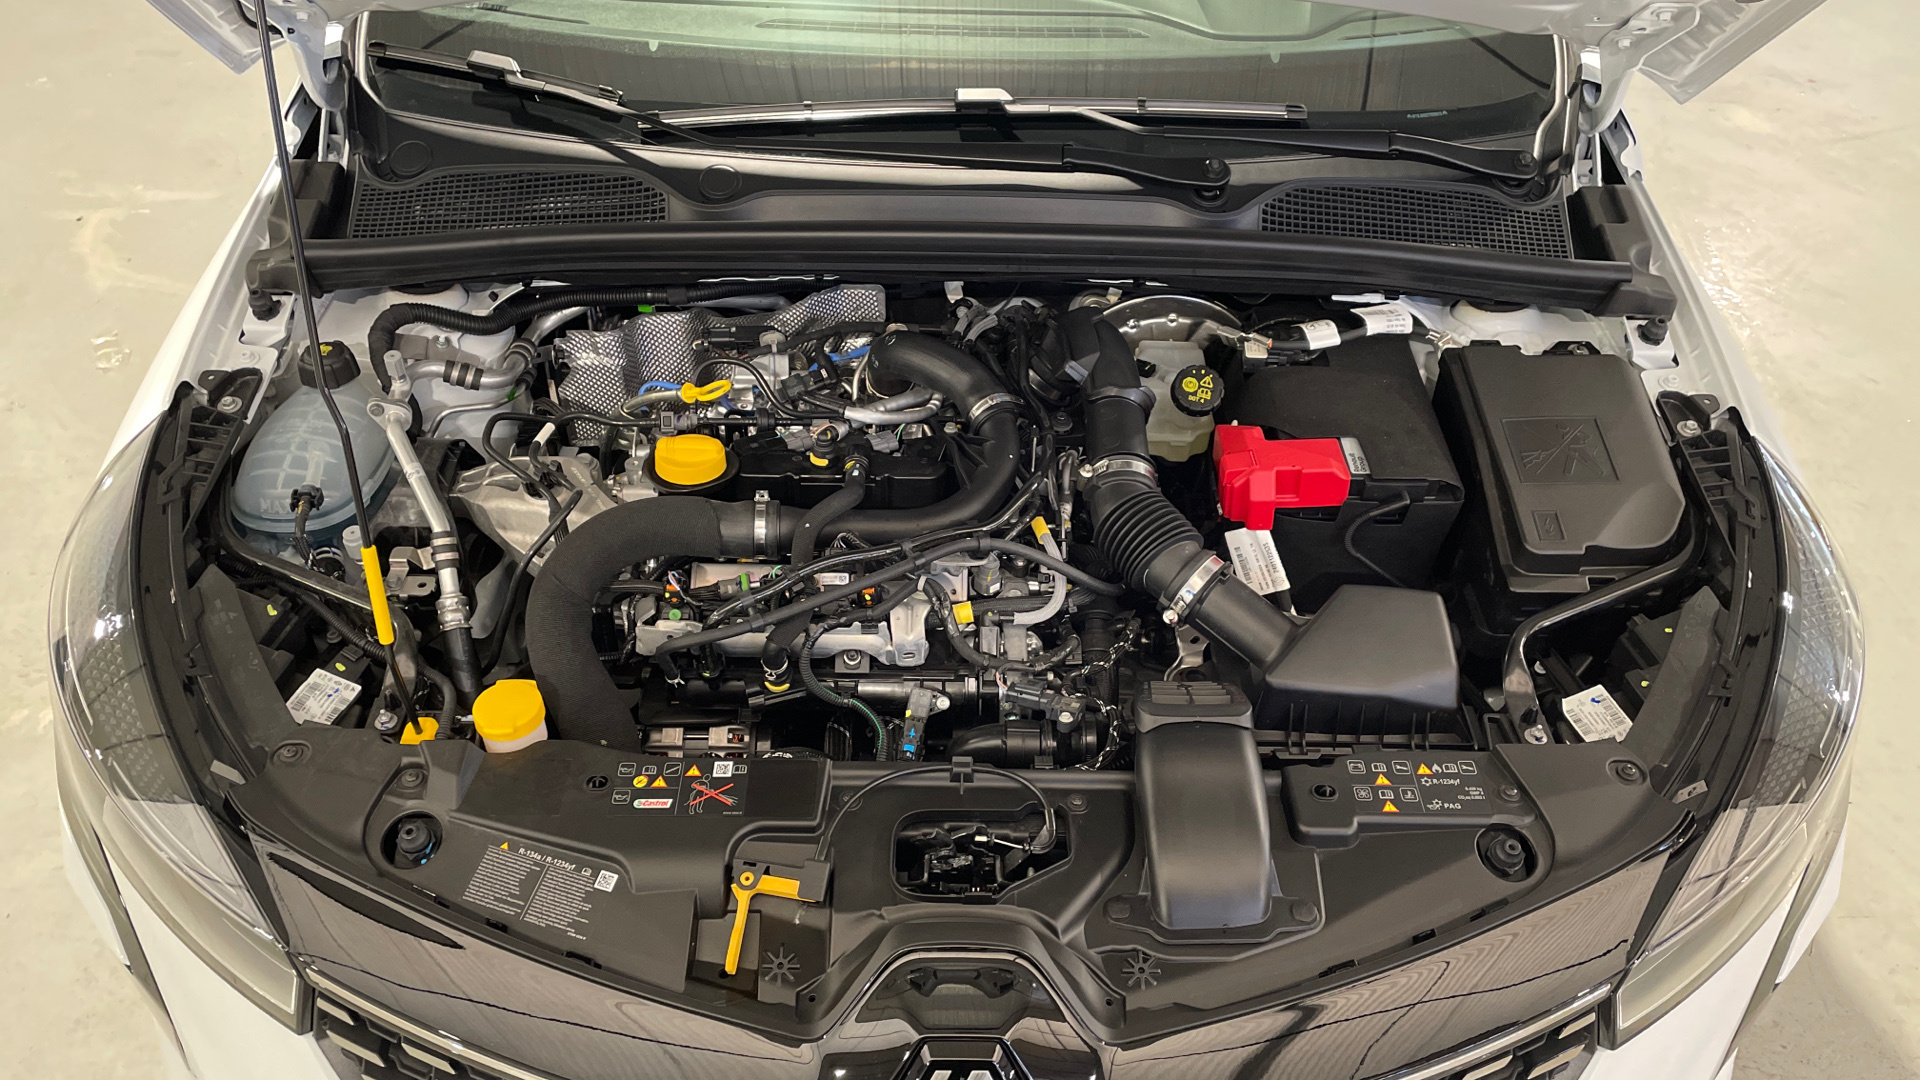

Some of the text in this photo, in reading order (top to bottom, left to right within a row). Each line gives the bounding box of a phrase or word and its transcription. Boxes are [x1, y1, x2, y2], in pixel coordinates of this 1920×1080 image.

[1357, 455, 1367, 472] Group
[1432, 778, 1460, 786] R-1234yf
[518, 847, 542, 861] R-134a
[545, 856, 576, 871] R-1234yf
